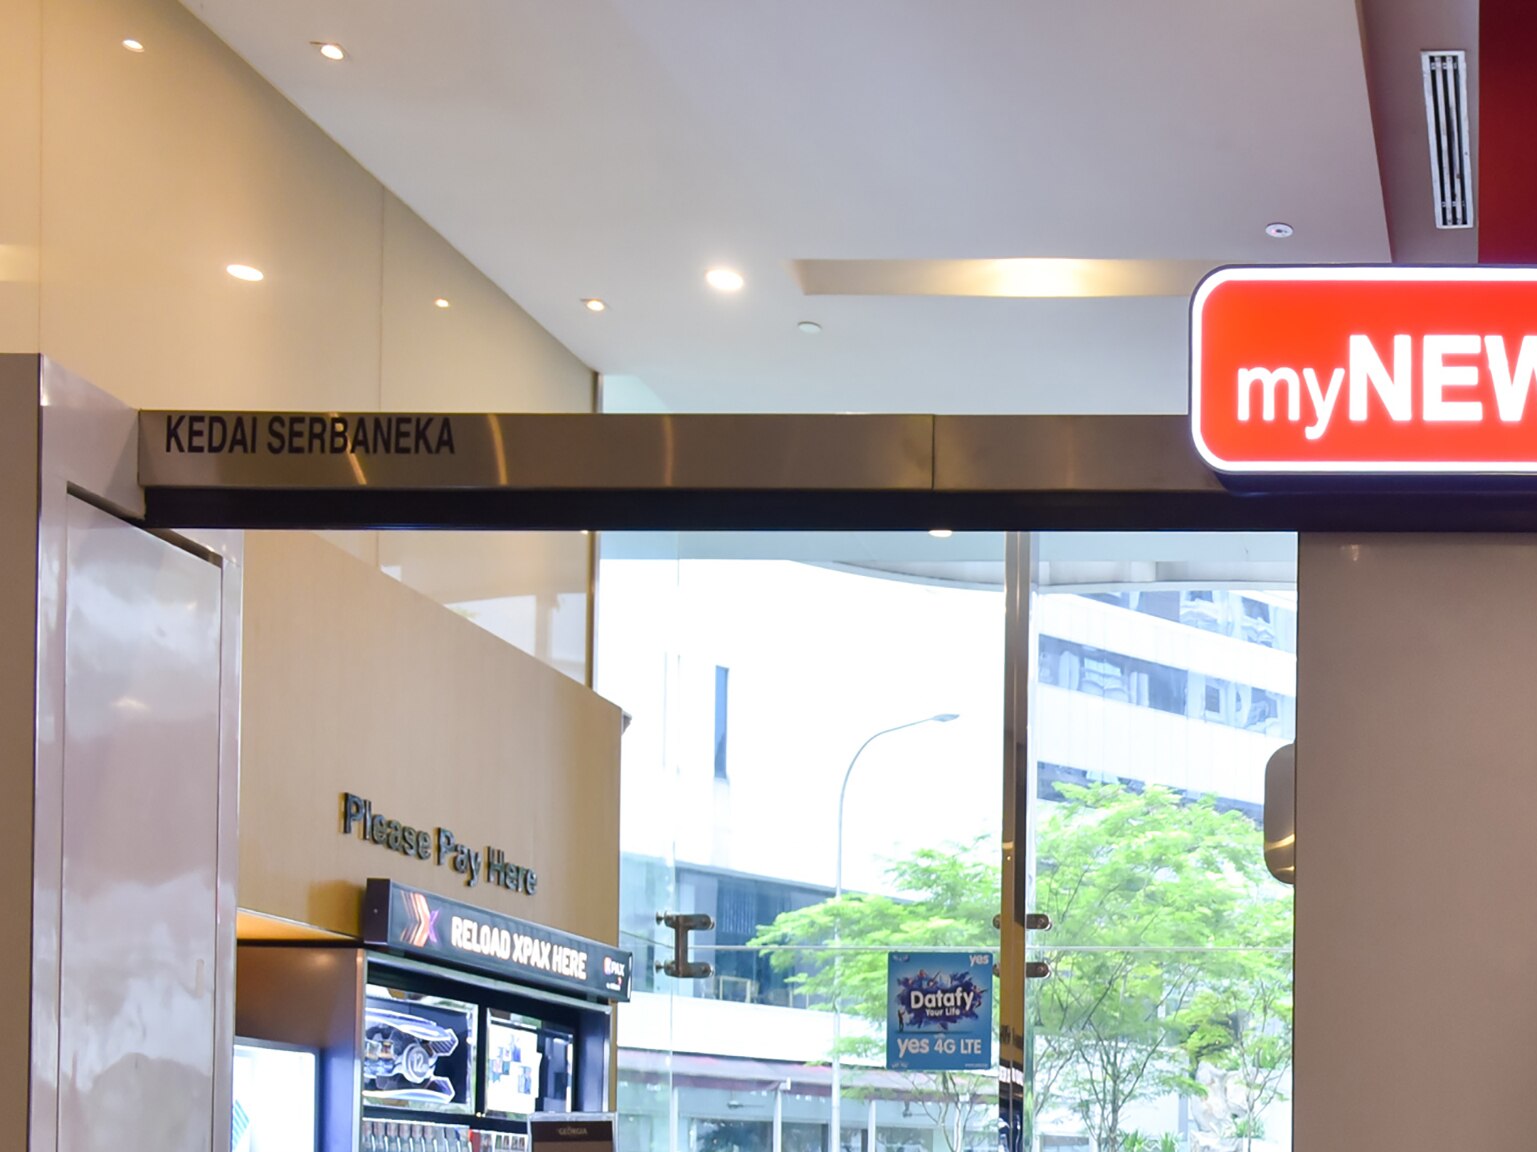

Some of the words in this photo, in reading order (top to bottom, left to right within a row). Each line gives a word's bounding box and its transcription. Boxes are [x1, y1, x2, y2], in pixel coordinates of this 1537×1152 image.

[165, 415, 257, 454] KEDAI
[267, 416, 455, 455] SERBANEKA
[343, 792, 432, 860] Please
[437, 827, 481, 887] Pay
[487, 846, 538, 895] Here
[451, 916, 511, 961] RELOAD
[512, 934, 552, 970] XPAX
[552, 944, 588, 980] HERE
[969, 955, 989, 967] yes
[910, 987, 975, 1011] Datafy
[897, 1038, 929, 1058] yes
[934, 1038, 956, 1054] 4G
[960, 1039, 982, 1054] LTE
